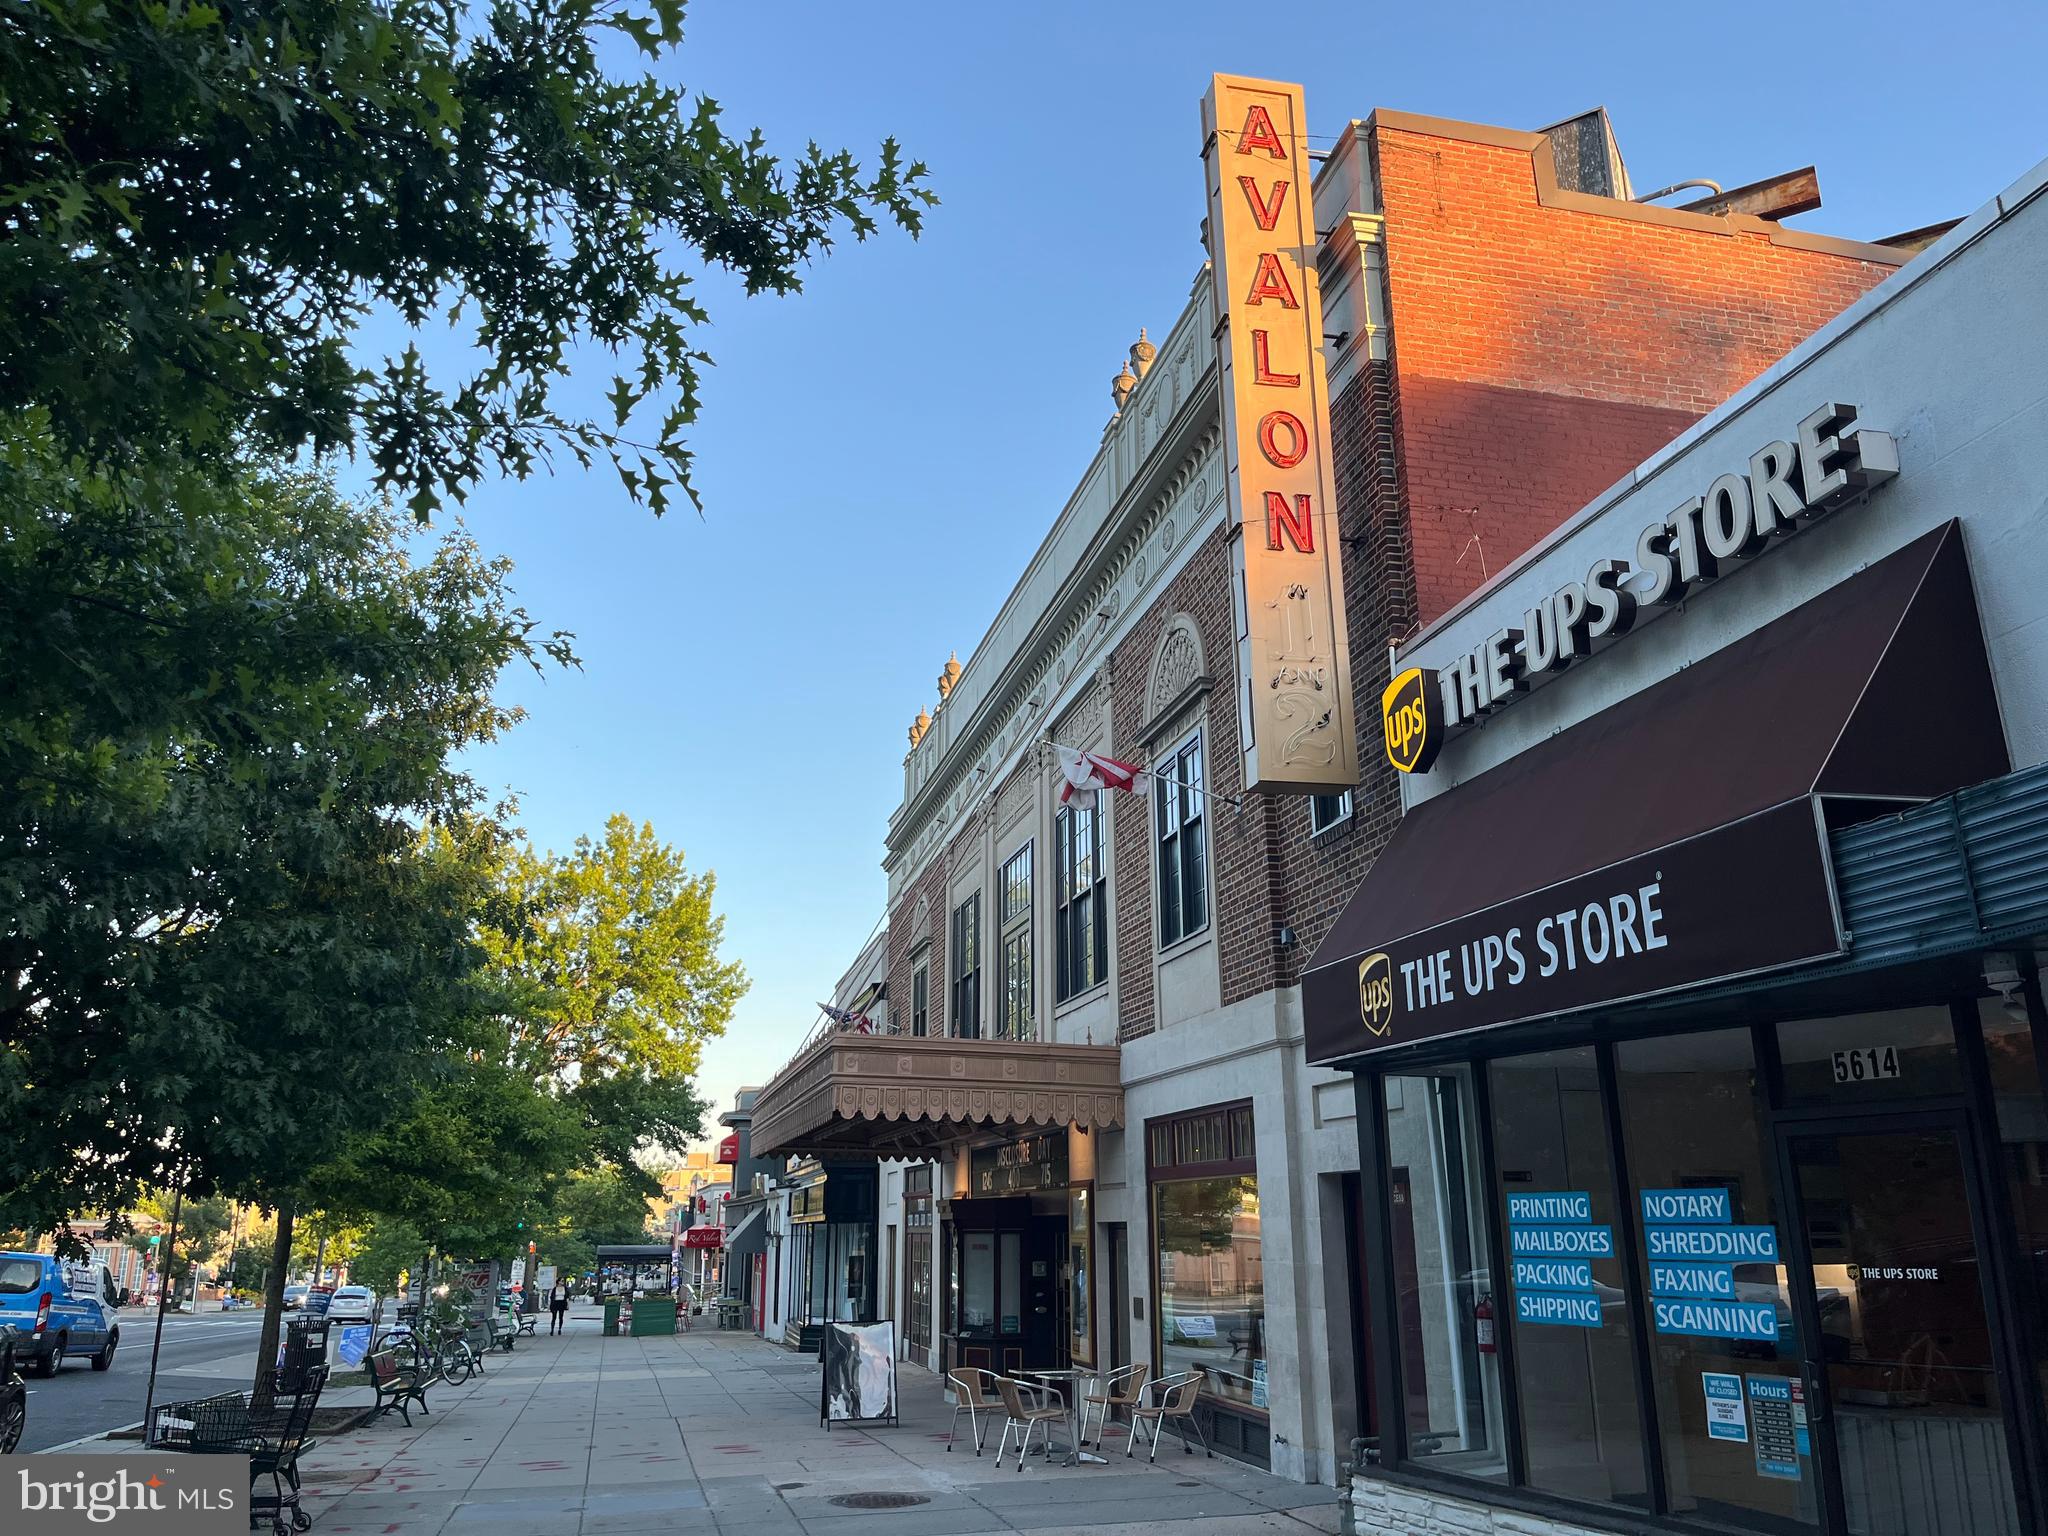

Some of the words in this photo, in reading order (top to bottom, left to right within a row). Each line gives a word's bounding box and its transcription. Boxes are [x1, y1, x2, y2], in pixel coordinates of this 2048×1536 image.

[1236, 105, 1315, 553] AVALON
[1438, 628, 1516, 728] THE
[1523, 559, 1622, 673] UPS
[1636, 402, 1858, 606] STORE
[1387, 704, 1424, 757] ups
[1400, 949, 1454, 1012] THE
[1460, 928, 1526, 996] UPS
[1535, 883, 1669, 978] STORE
[1362, 976, 1391, 1023] ups
[1833, 1047, 1898, 1081] 5614
[1037, 1137, 1051, 1160] DAY
[1510, 1196, 1588, 1219] PRINTING
[1645, 1195, 1724, 1218] NOTARY
[1514, 1230, 1610, 1253] MAILBOXES
[1650, 1231, 1774, 1256] SHREDDING
[1516, 1263, 1589, 1287] PACKING
[1654, 1268, 1731, 1294] FAXING
[1862, 1267, 1881, 1279] THE
[1883, 1267, 1904, 1280] UPS
[1906, 1268, 1939, 1280] STORE
[1519, 1296, 1599, 1322] SHIPPING
[1655, 1304, 1775, 1336] SCANNING
[1750, 1381, 1788, 1399] Hours
